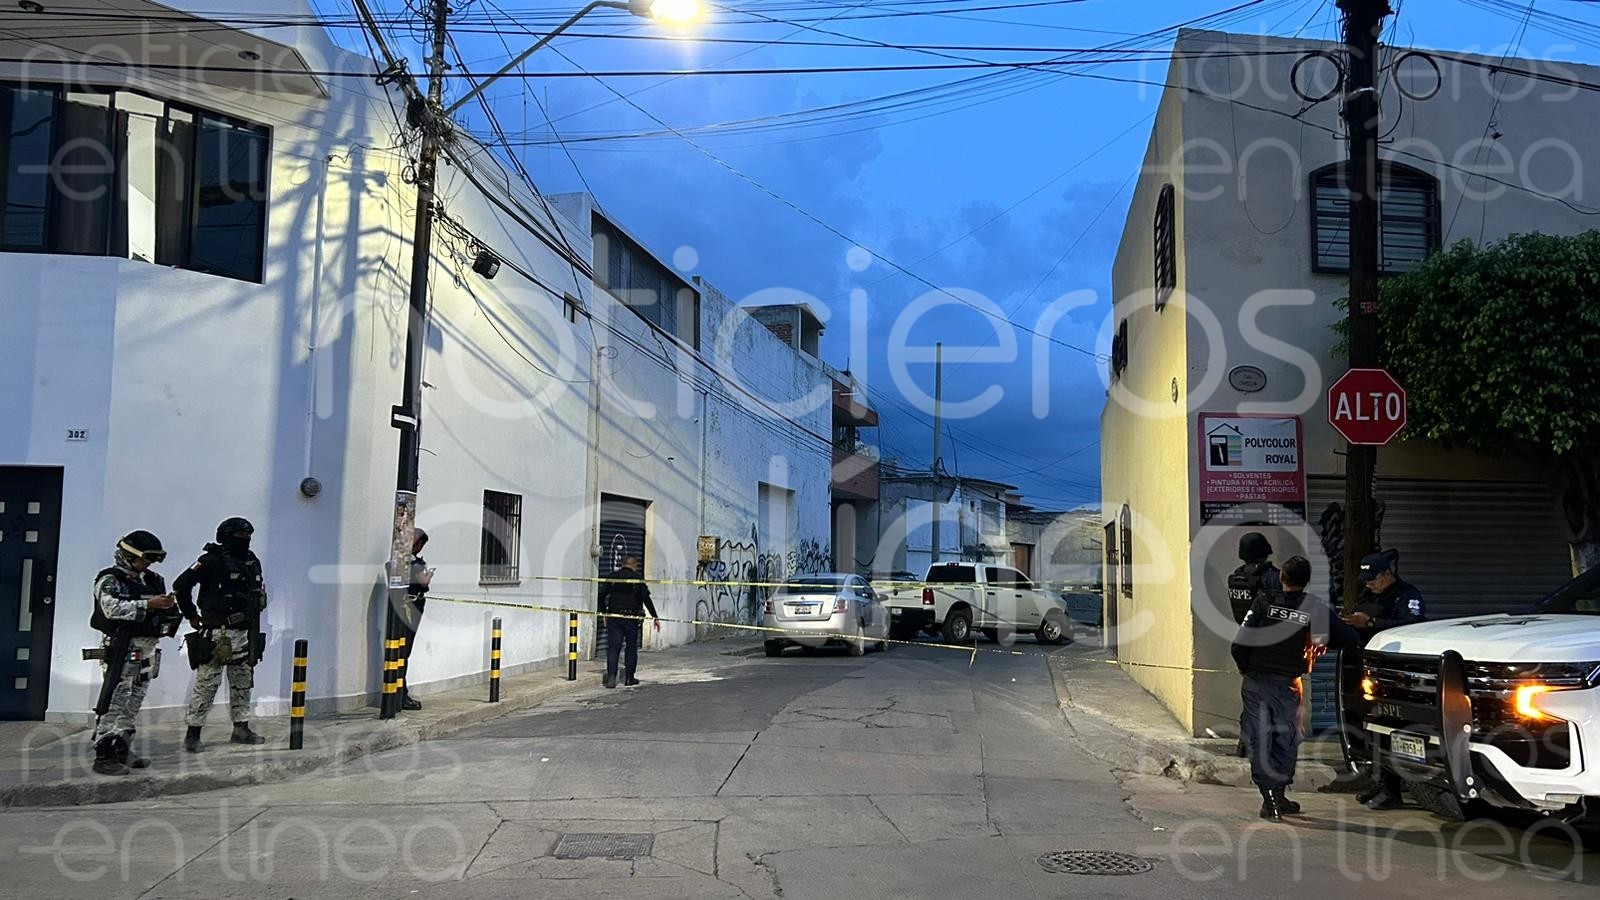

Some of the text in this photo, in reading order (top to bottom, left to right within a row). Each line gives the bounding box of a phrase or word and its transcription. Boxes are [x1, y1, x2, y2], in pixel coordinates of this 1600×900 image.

[1334, 392, 1400, 421] ALTO
[69, 430, 85, 439] 302
[1245, 438, 1296, 448] POLYCOLOR
[1265, 454, 1296, 464] ROYAL
[1228, 588, 1251, 600] FSPE
[1269, 607, 1308, 623] FSPE
